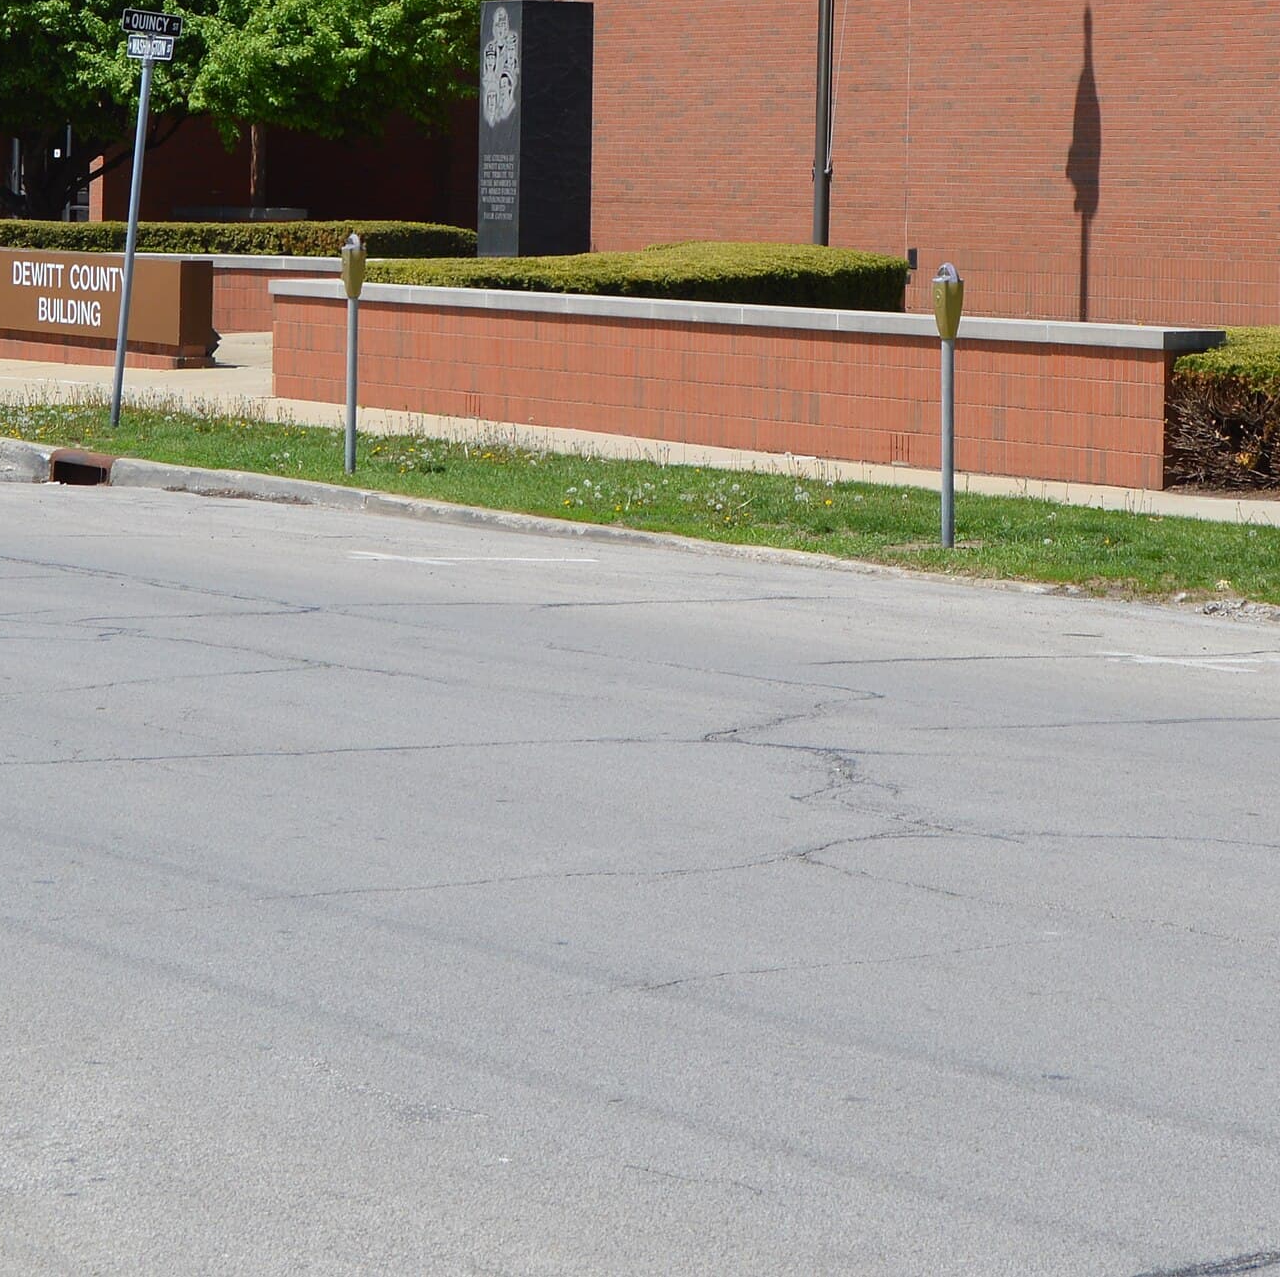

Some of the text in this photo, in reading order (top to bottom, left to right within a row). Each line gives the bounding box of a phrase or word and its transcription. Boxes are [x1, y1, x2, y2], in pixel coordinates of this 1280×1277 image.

[131, 13, 169, 33] QUINCY
[13, 260, 64, 288] DEWITT
[38, 297, 101, 326] BUILDING
